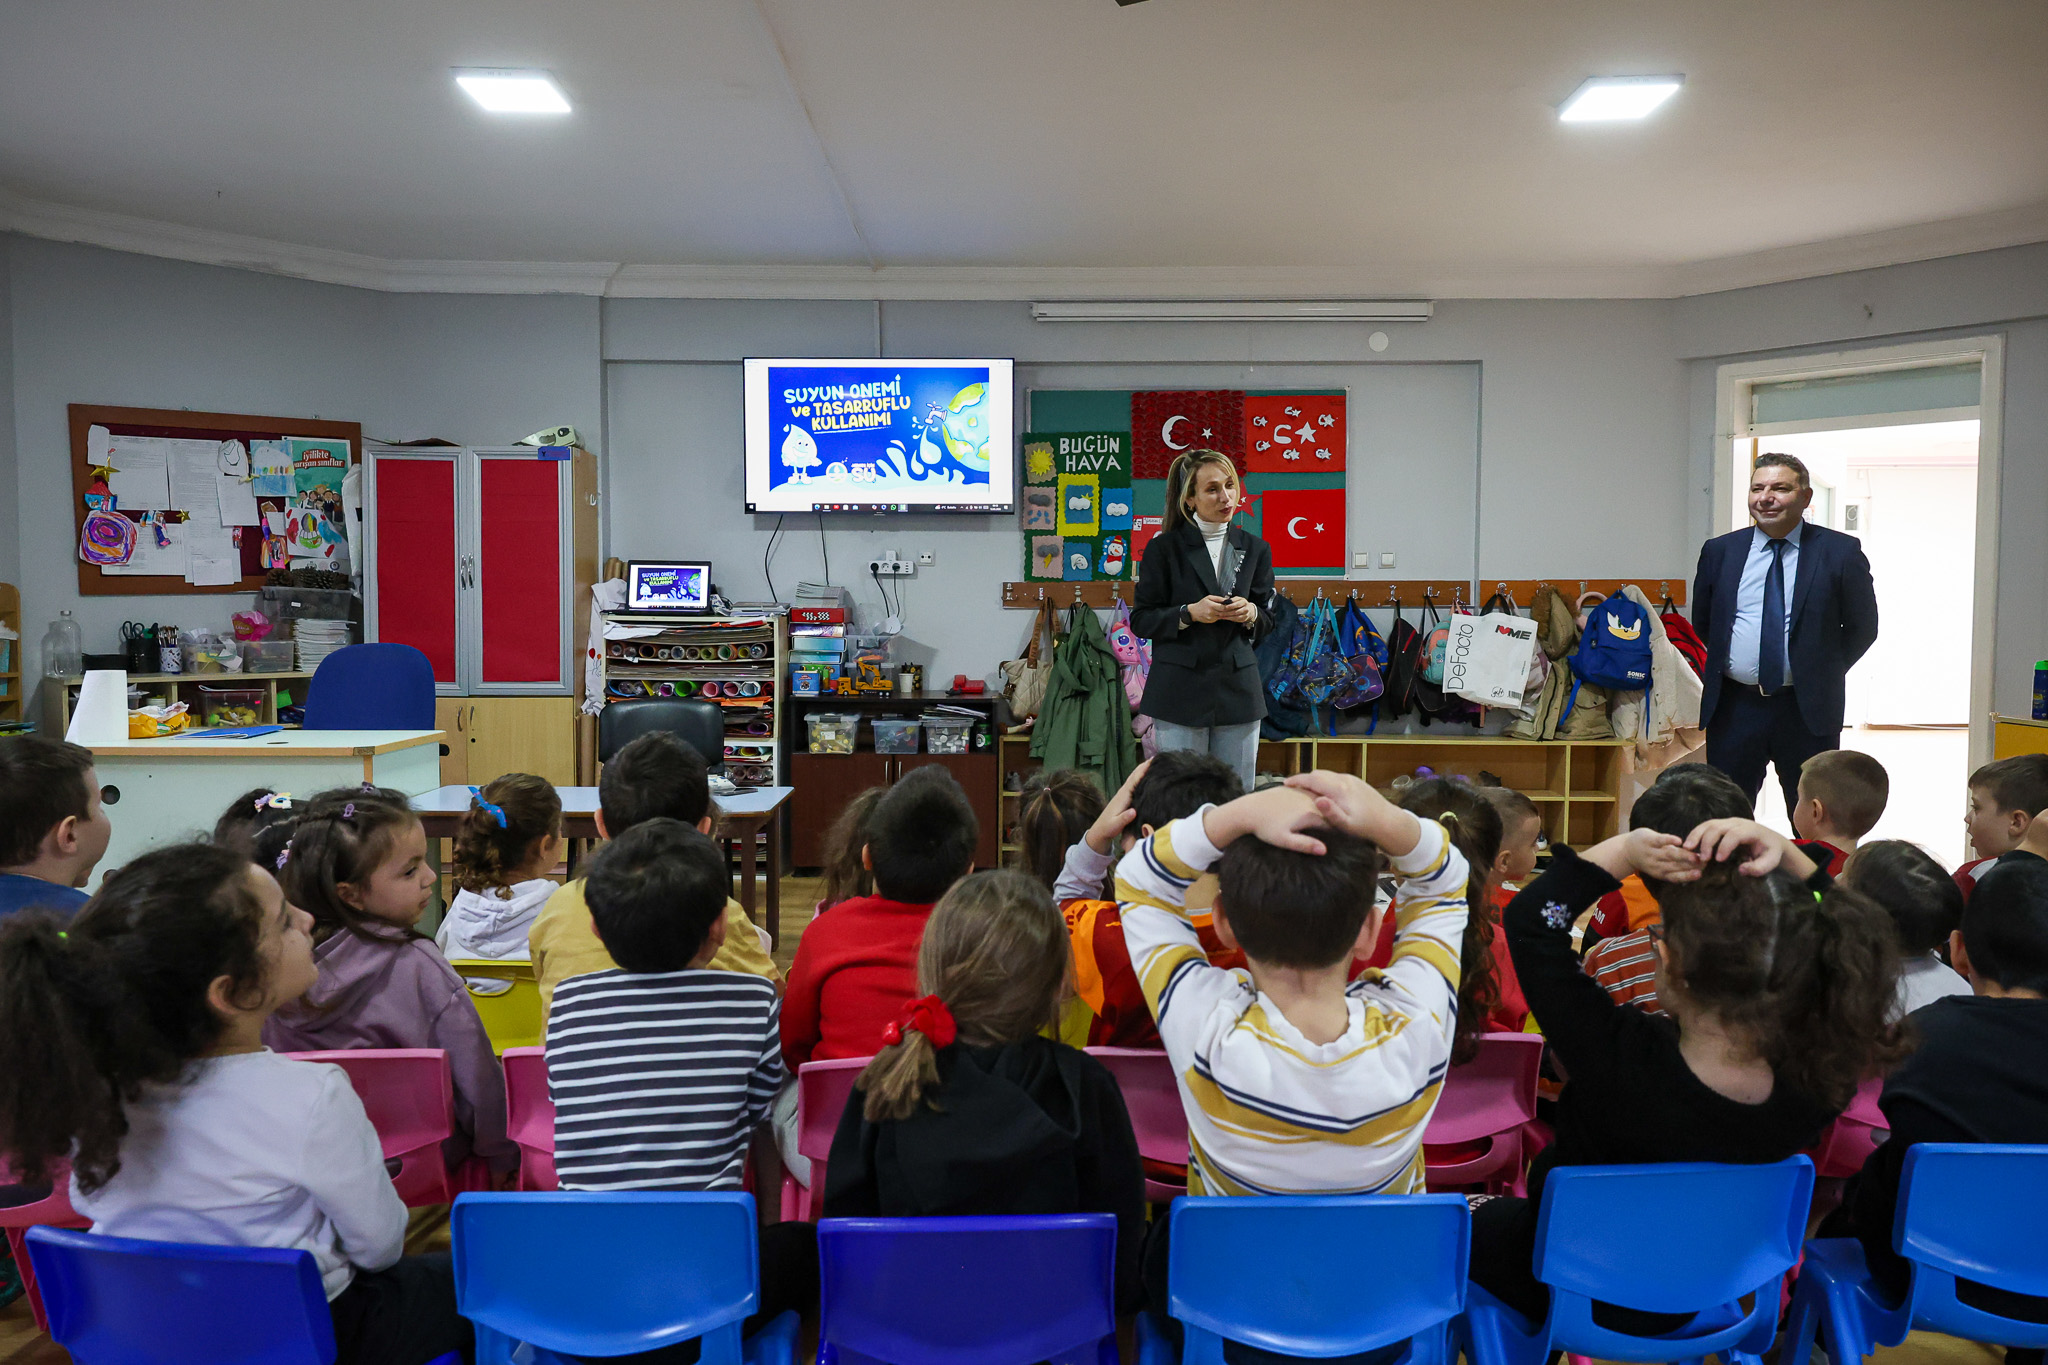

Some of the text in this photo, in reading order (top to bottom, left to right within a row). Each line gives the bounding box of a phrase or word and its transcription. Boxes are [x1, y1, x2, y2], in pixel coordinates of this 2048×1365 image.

[783, 386, 845, 404] SUYUN
[791, 396, 911, 418] ve TASARRUFLU
[811, 412, 892, 431] KULLANIMI
[1059, 434, 1120, 455] BUGÜN
[303, 449, 329, 461] iyilikte
[318, 458, 343, 467] sınıflar
[1065, 454, 1122, 472] HAVA
[1447, 623, 1474, 690] DeFacto
[1627, 670, 1646, 678] SONIC
